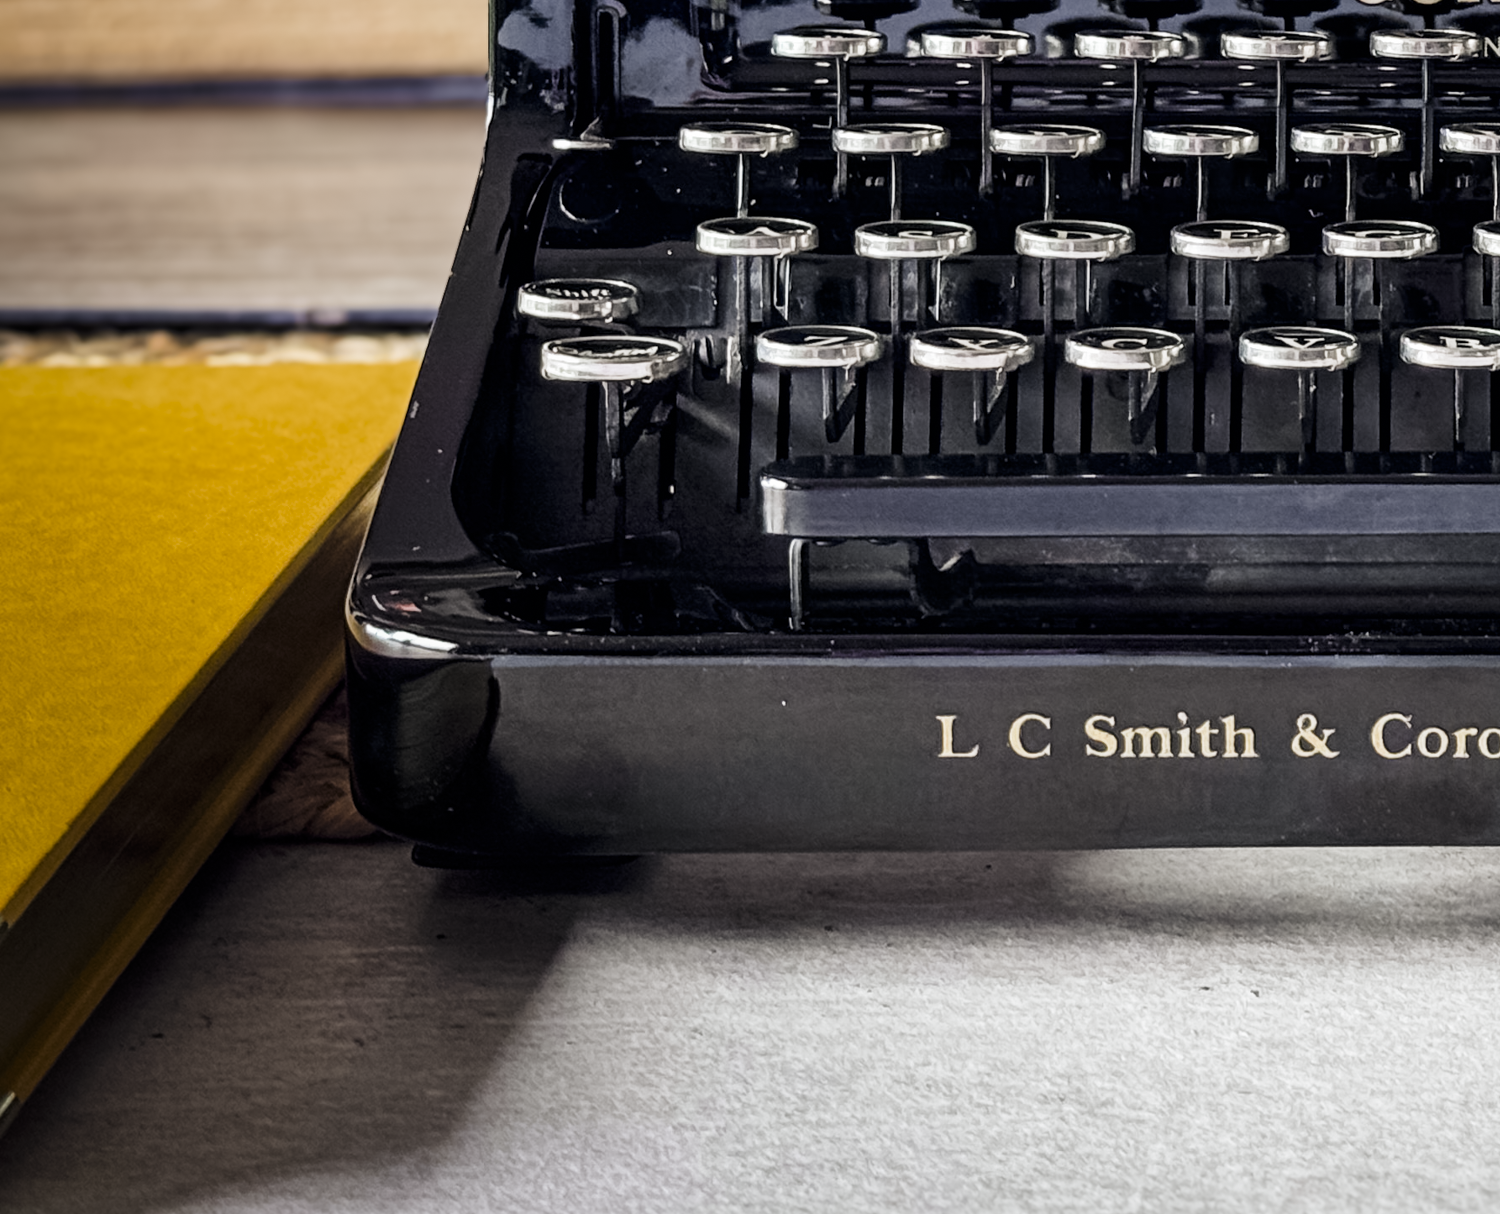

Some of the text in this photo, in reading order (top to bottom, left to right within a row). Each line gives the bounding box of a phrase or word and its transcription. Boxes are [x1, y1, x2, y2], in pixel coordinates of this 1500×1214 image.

[936, 715, 980, 758] L
[1007, 714, 1051, 759] C
[1085, 712, 1259, 759] Smith
[1291, 714, 1341, 759] &
